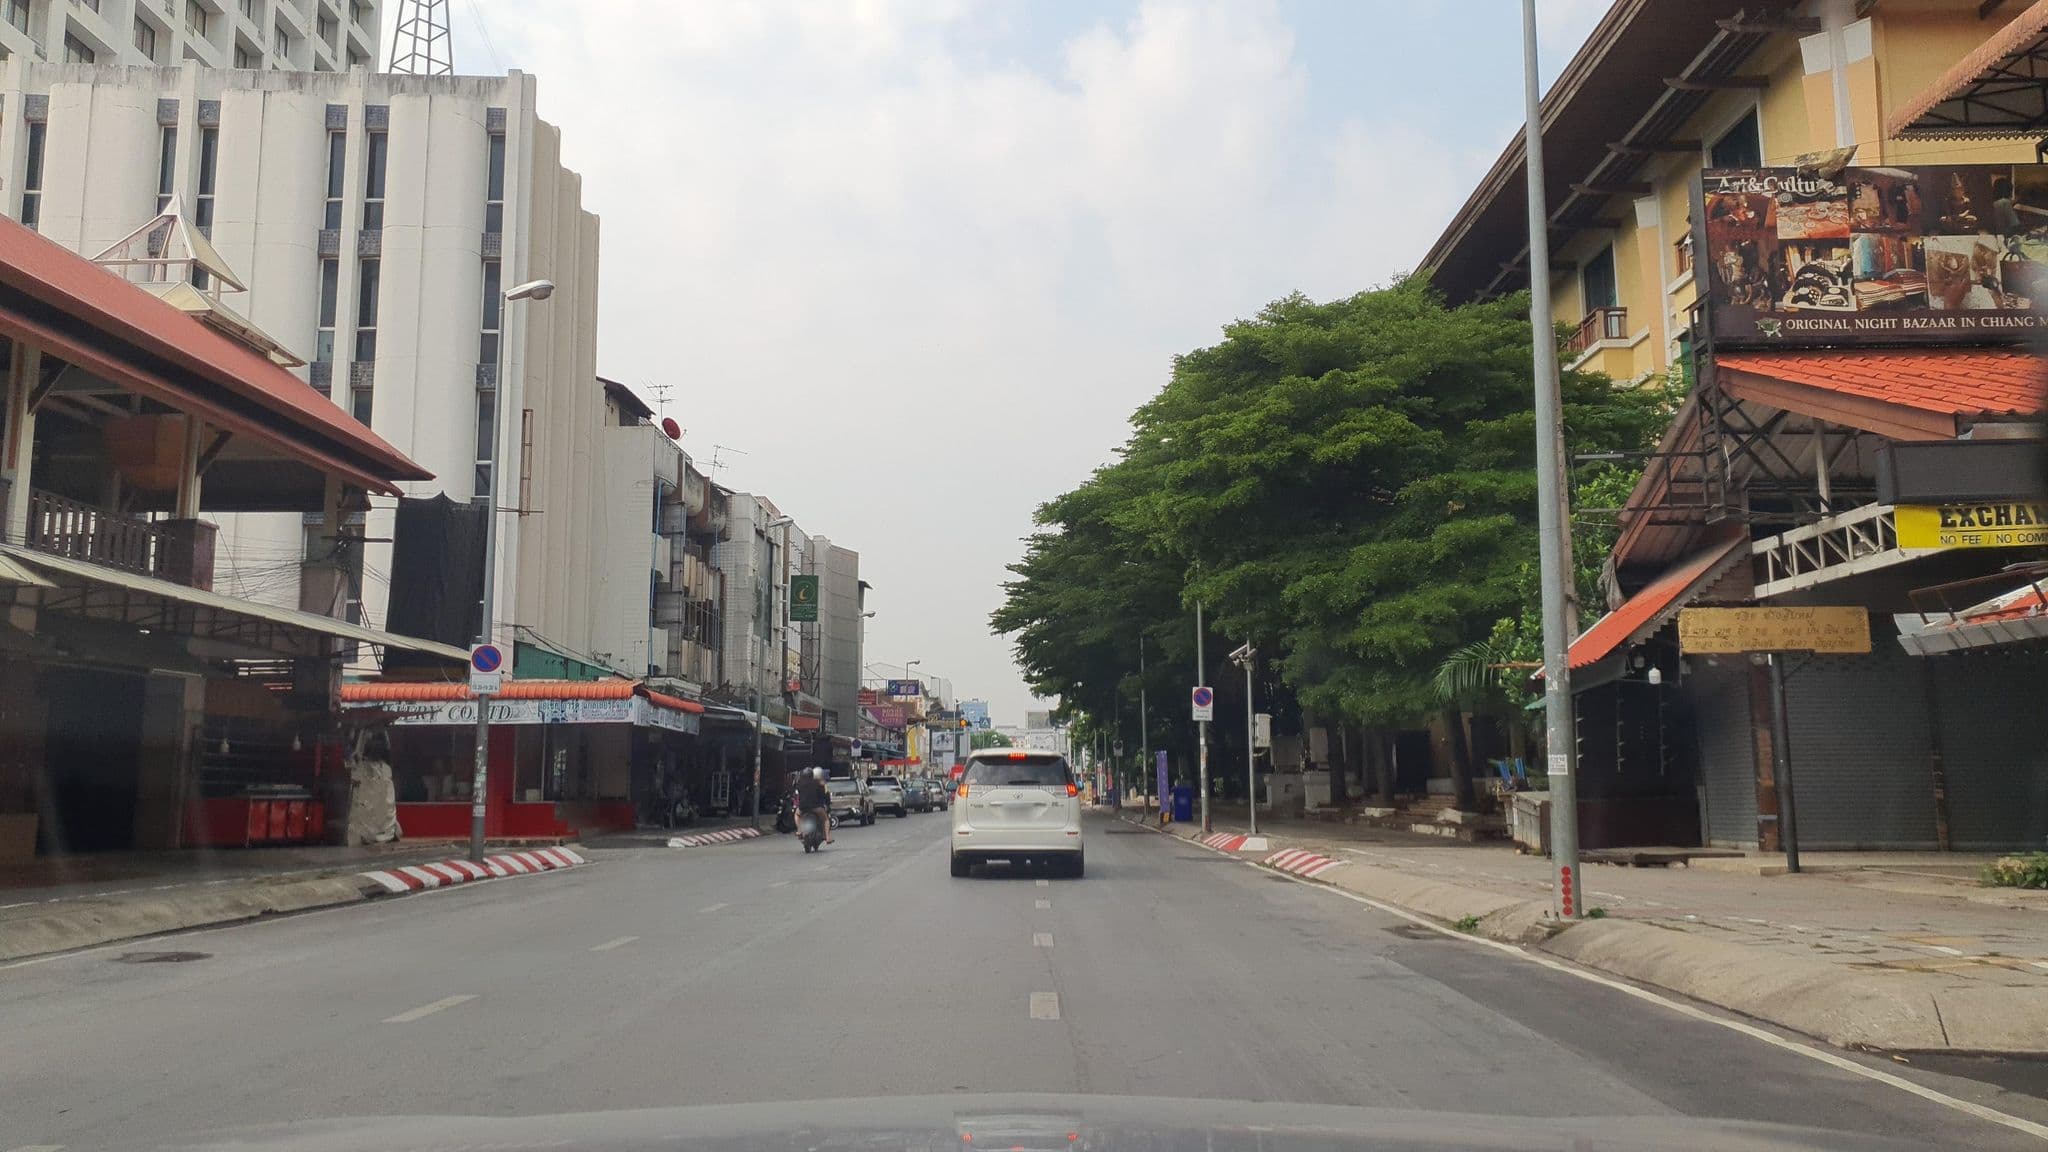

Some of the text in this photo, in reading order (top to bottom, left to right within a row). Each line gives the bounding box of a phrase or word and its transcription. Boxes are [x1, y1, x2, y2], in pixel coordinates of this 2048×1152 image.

[1786, 320, 1850, 330] ORIGINAL
[1855, 319, 1897, 329] NIGHT
[1903, 318, 1956, 329] BAZAAR
[1961, 318, 1975, 328] IN
[1980, 316, 2034, 327] CHIANG
[1940, 535, 1957, 545] NO
[1962, 535, 1982, 544] FEE
[1996, 534, 2012, 543] NO
